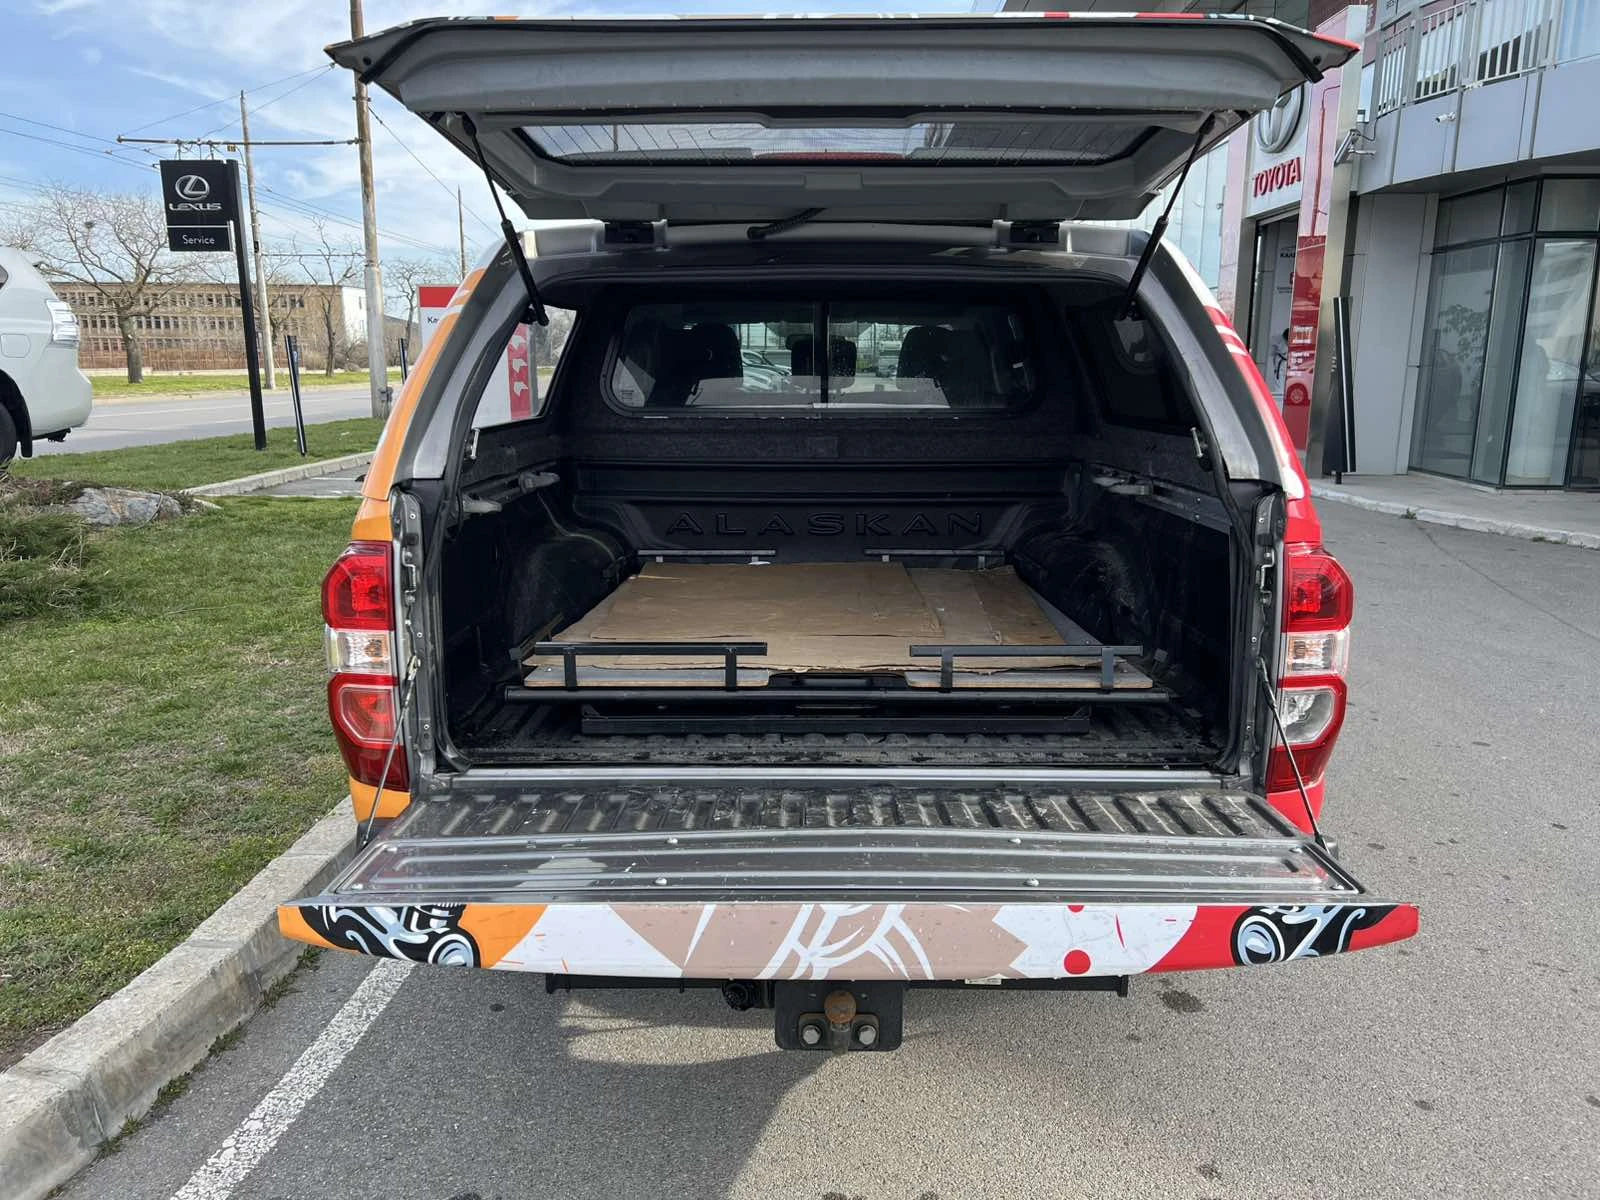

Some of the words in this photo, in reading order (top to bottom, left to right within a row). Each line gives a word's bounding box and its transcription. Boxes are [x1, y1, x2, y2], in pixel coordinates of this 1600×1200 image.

[1252, 156, 1301, 198] TOYOTA
[168, 202, 222, 211] LEXUS
[182, 234, 215, 245] Service
[665, 510, 985, 537] ALASKAN
